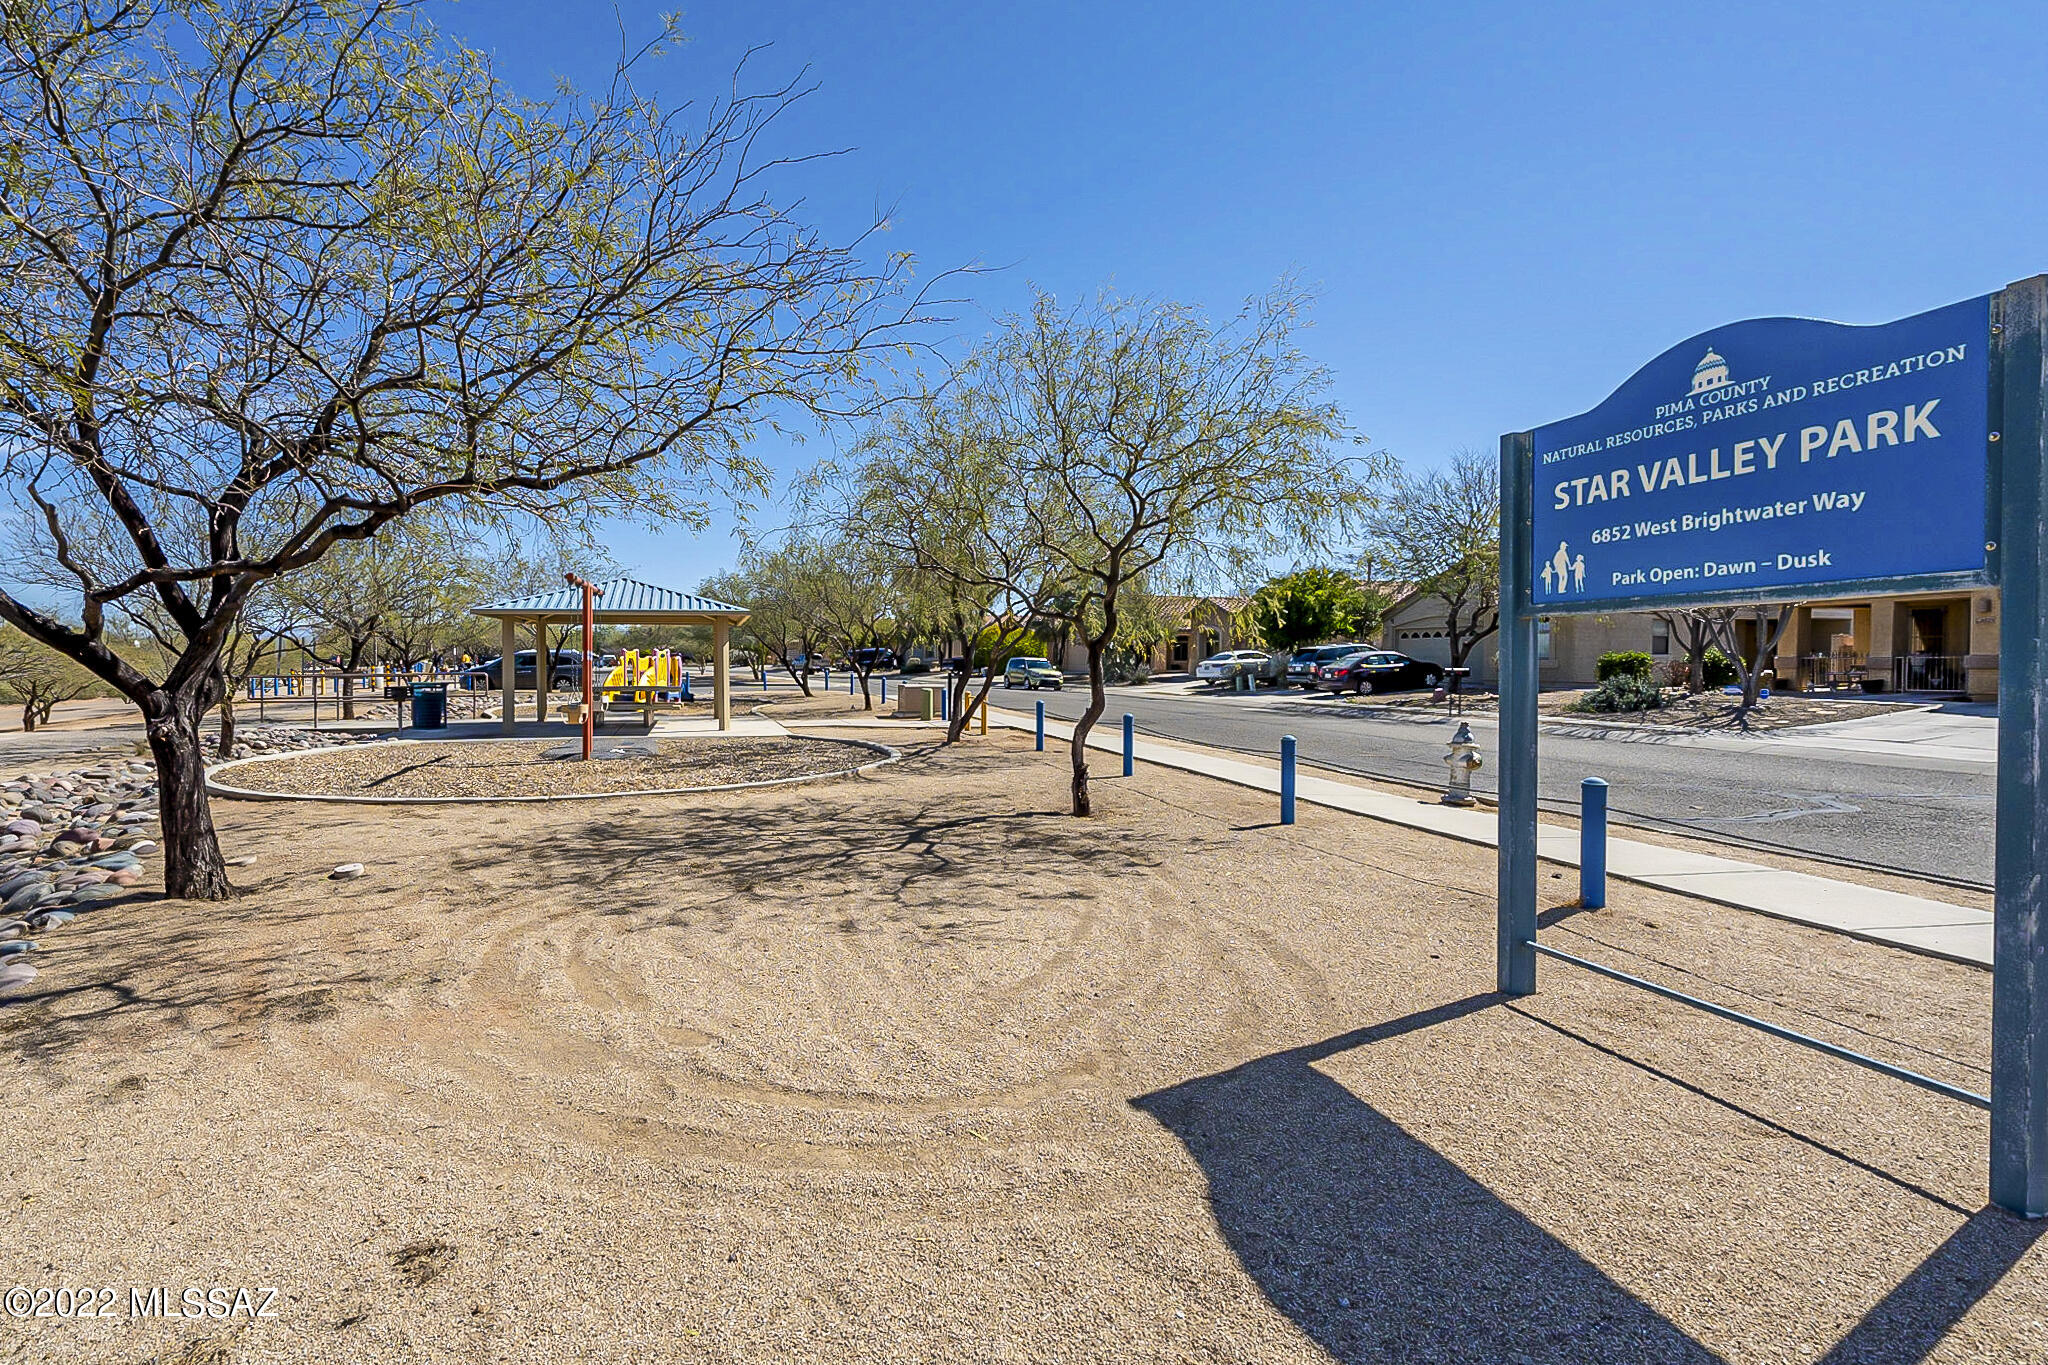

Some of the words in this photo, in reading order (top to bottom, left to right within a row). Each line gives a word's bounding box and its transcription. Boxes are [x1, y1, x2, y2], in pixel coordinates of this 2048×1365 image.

[1542, 440, 1603, 465] NATURAL
[1606, 416, 1698, 449] RESOURCES,
[1702, 399, 1759, 424] PARKS
[1763, 386, 1808, 408] AND
[1813, 343, 1967, 397] RECREATION
[1655, 399, 1696, 419] PIMA
[1699, 376, 1772, 408] COUNTY
[1553, 468, 1631, 510] STAR
[1638, 432, 1786, 493] VALLEY
[1799, 398, 1942, 463] PARK
[1591, 526, 1631, 544] 6852
[1634, 518, 1677, 538] West
[1682, 499, 1808, 531] Brightwater
[1812, 490, 1866, 513] Way
[1611, 570, 1646, 586] Park
[1650, 566, 1700, 585] Open:
[1703, 560, 1757, 578] Dawn
[1777, 549, 1832, 570] Dusk
